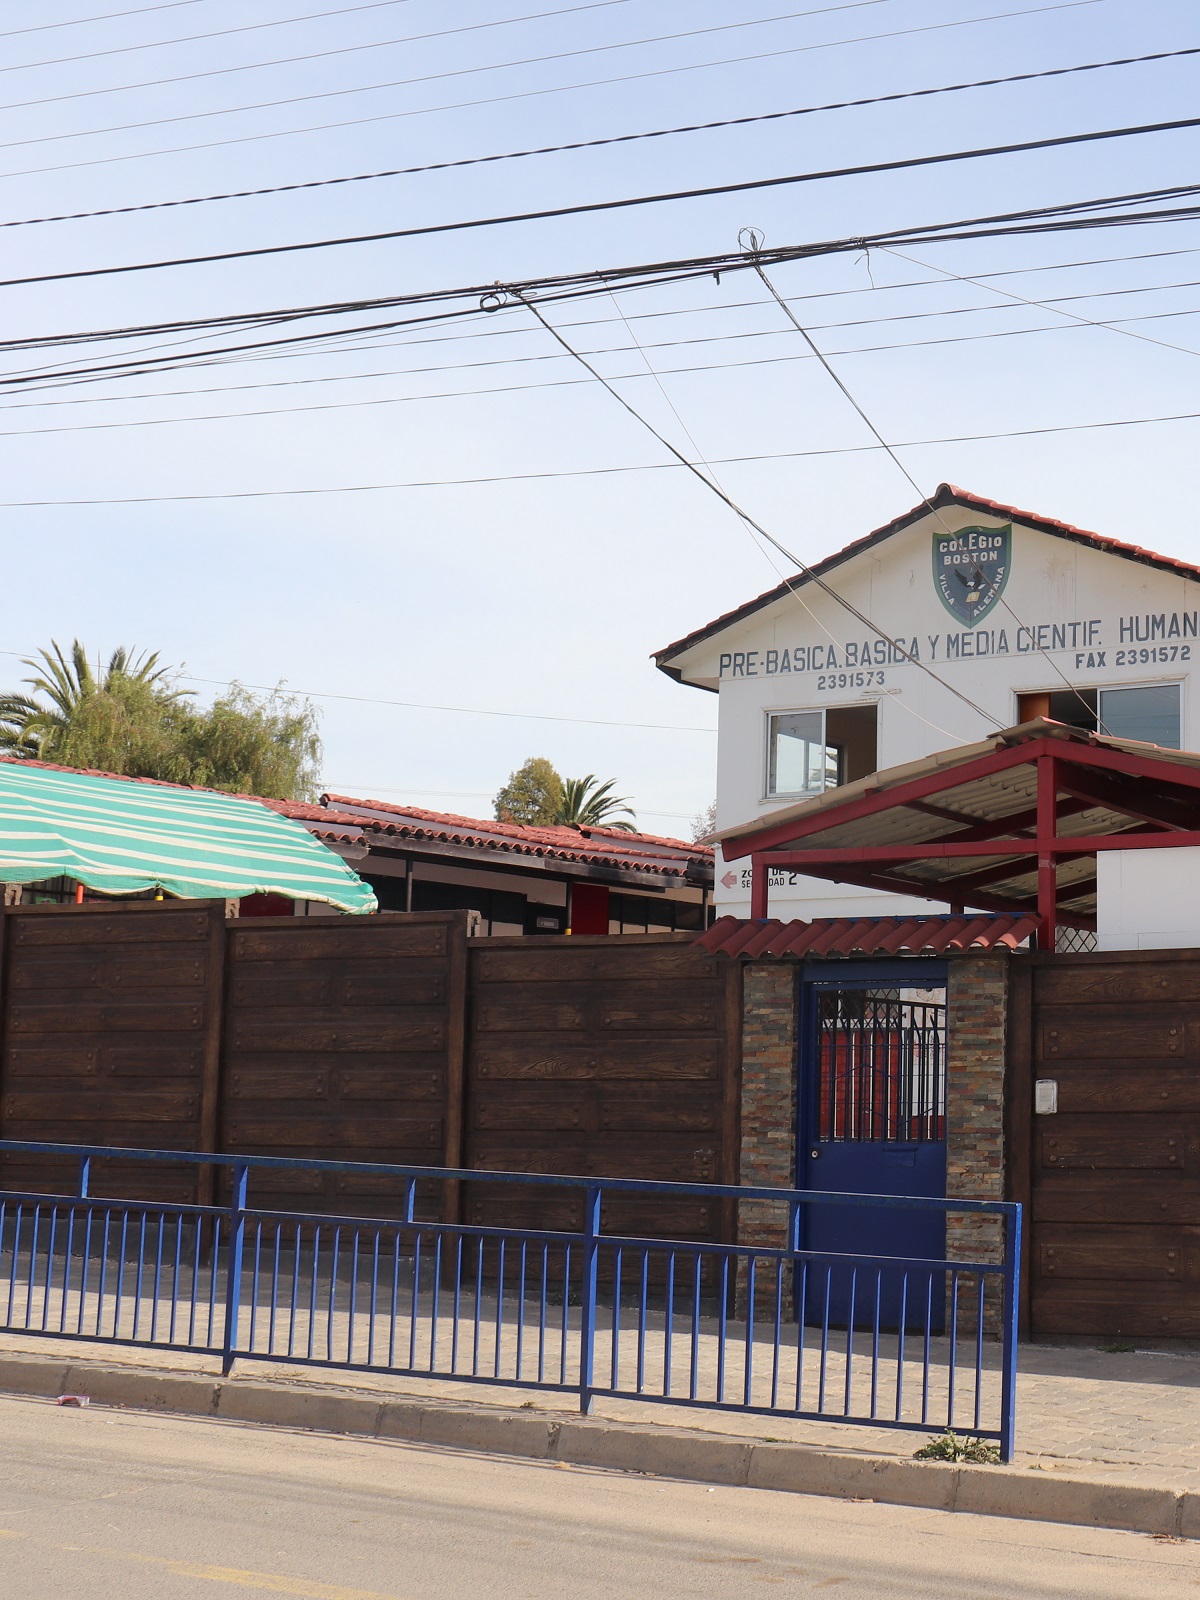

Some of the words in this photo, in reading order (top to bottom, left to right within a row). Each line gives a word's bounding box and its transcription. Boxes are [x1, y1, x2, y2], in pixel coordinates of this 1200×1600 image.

[939, 533, 1003, 553] COLEGIO
[943, 551, 998, 566] BOSTON
[939, 574, 955, 606] VILLA
[973, 566, 1005, 617] ALEMANA
[927, 634, 940, 660] Y
[946, 628, 1009, 659] MEDIA
[1016, 619, 1102, 652] CIENTIF.
[1075, 651, 1107, 669] FAX
[1115, 645, 1191, 666] 2391572
[817, 670, 885, 691] 2391573
[788, 871, 797, 885] 2
